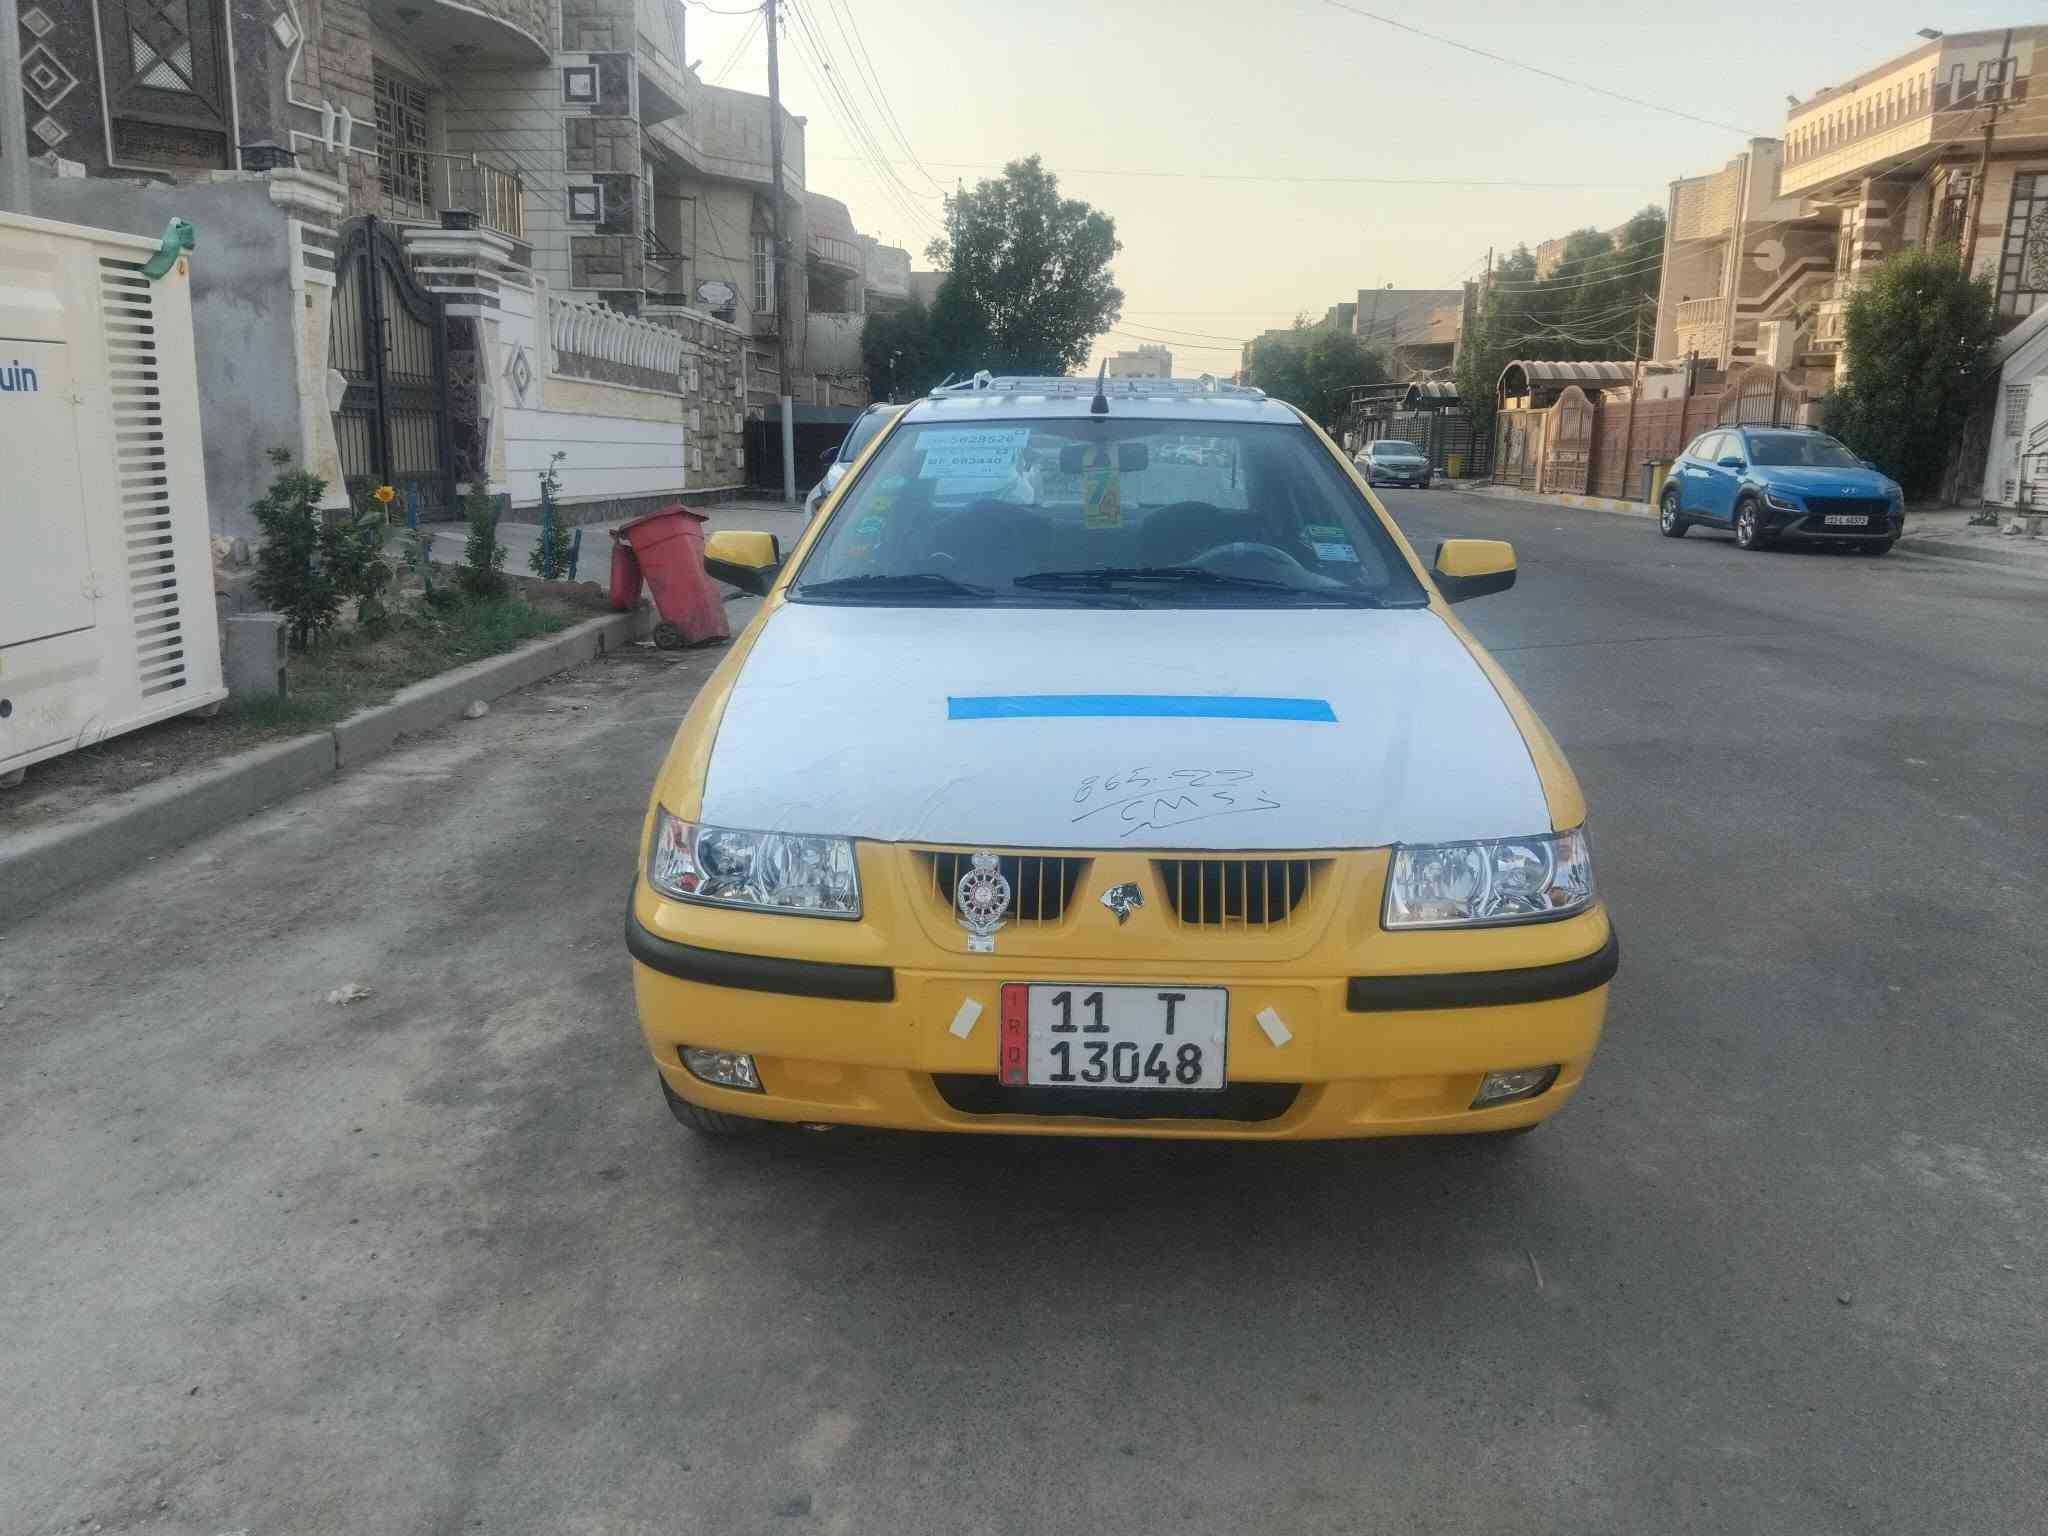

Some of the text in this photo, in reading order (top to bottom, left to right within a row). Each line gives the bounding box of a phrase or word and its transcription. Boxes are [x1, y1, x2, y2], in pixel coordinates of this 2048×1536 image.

[1051, 991, 1186, 1035] 11 T
[1049, 1041, 1203, 1084] 13048
